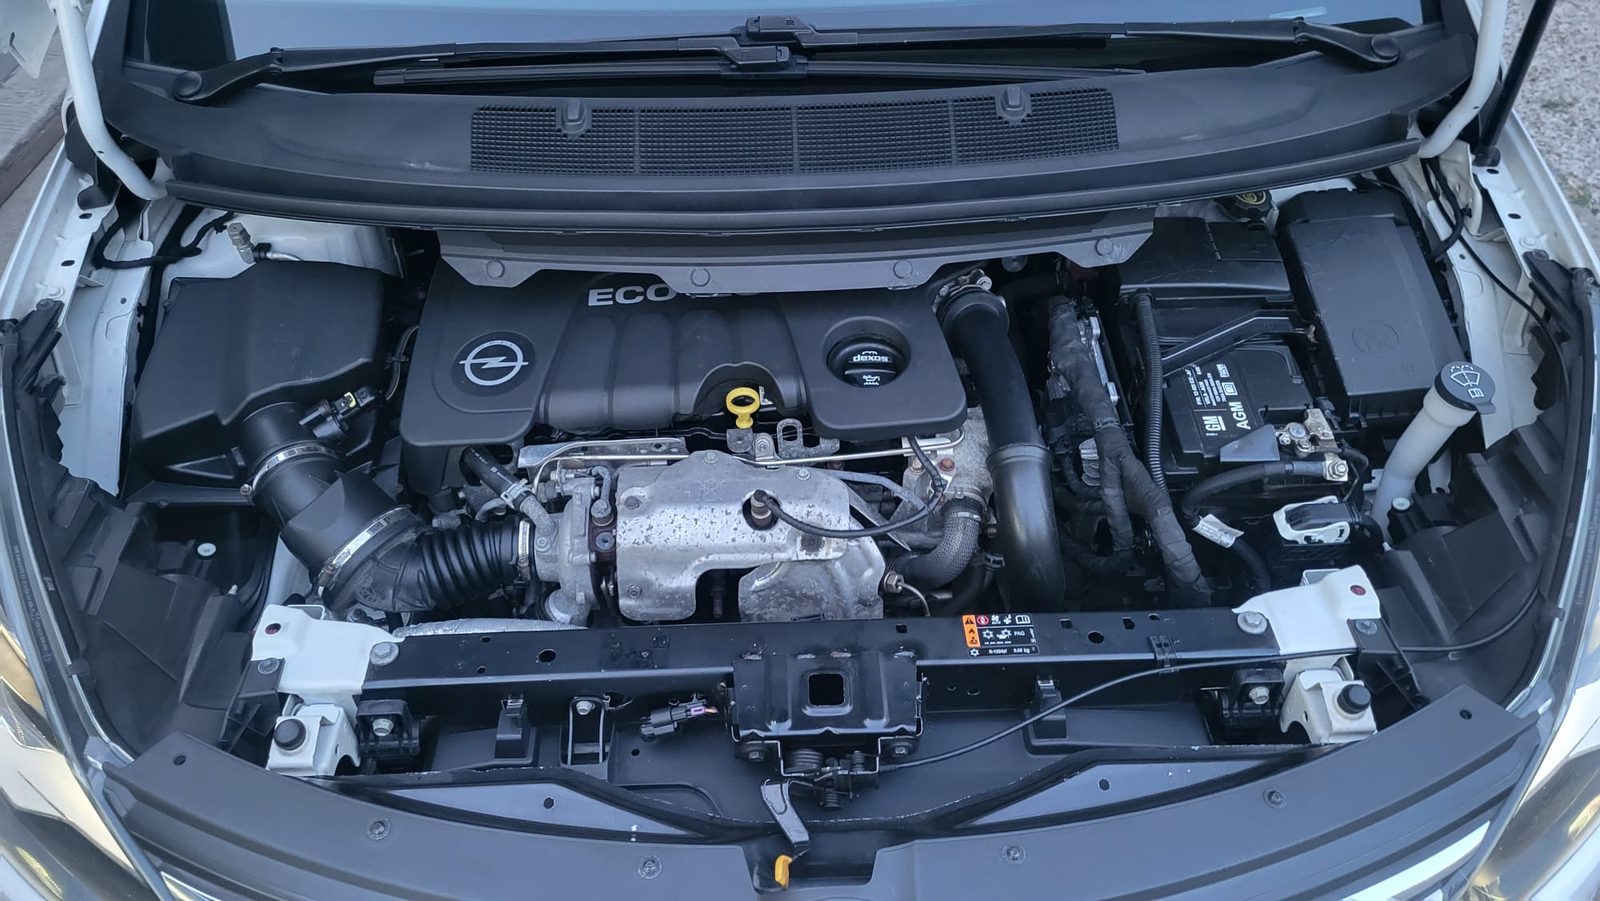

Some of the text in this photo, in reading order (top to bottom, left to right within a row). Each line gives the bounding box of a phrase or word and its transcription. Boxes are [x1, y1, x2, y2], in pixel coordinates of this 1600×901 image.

[853, 354, 889, 362] dexos
[1202, 415, 1222, 431] GM
[1228, 401, 1251, 430] AGM
